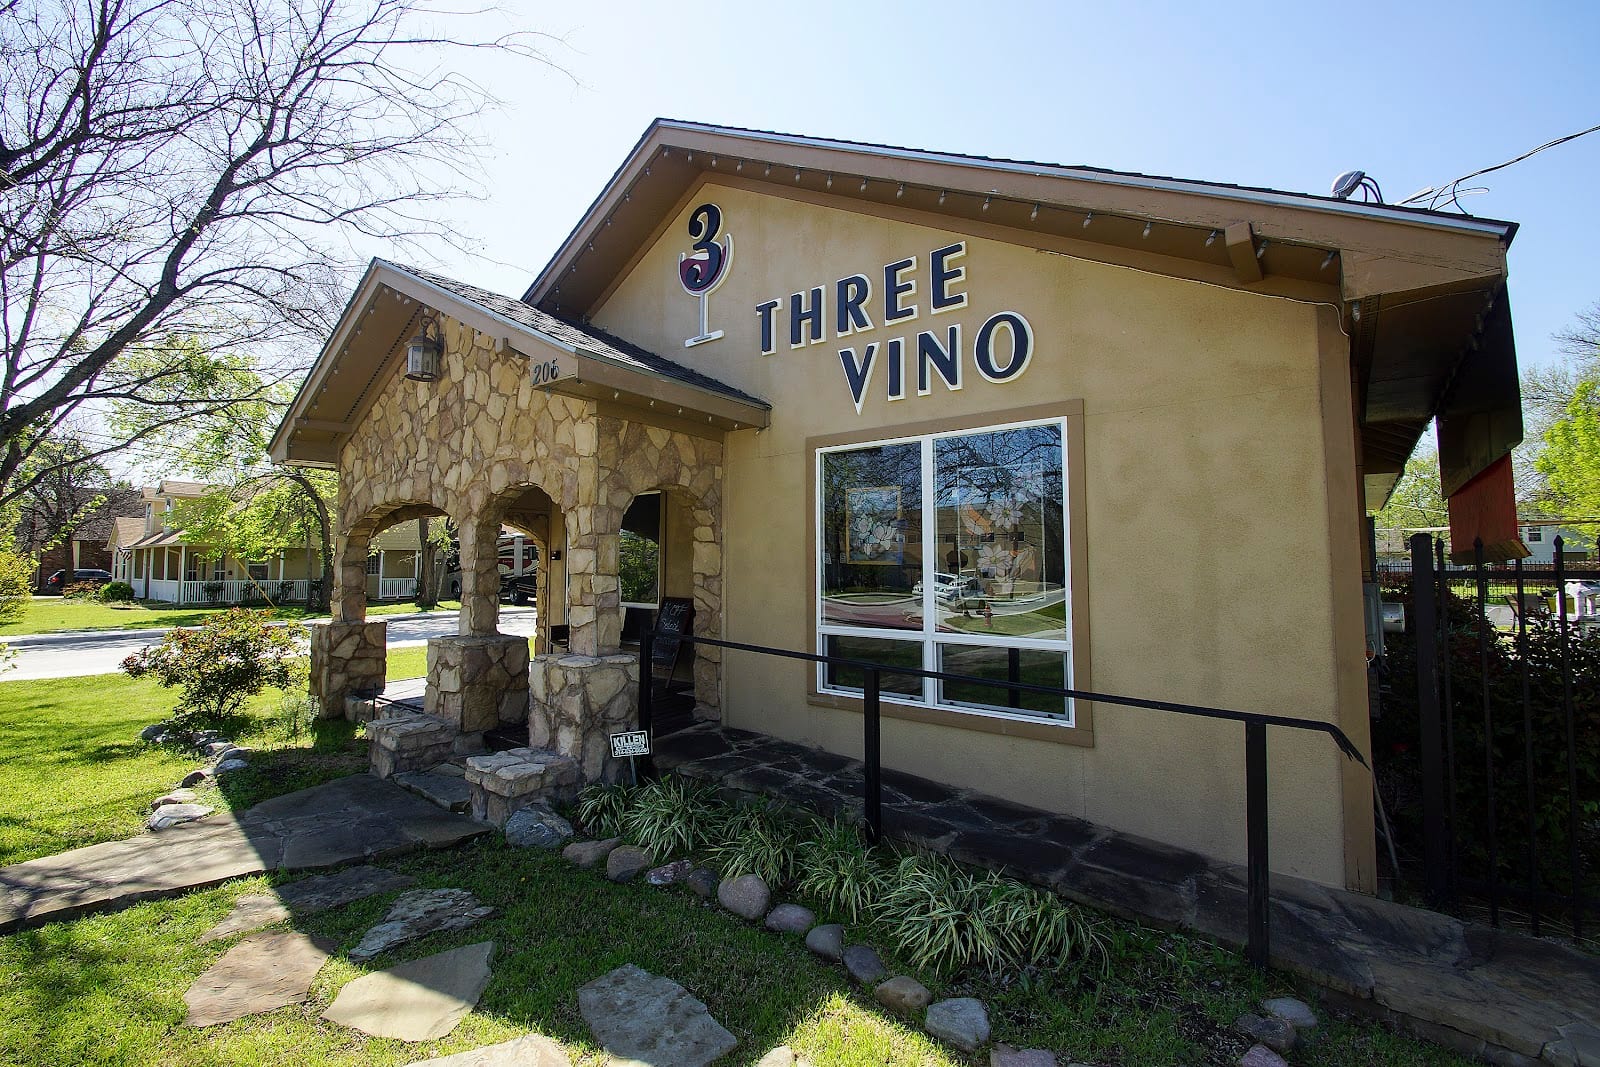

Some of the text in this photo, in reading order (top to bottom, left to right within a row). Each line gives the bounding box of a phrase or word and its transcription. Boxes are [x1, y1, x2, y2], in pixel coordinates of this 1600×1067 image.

[755, 240, 969, 356] THREE
[532, 357, 560, 385] 206
[837, 310, 1035, 416] VINO
[612, 734, 646, 748] KILLEN
